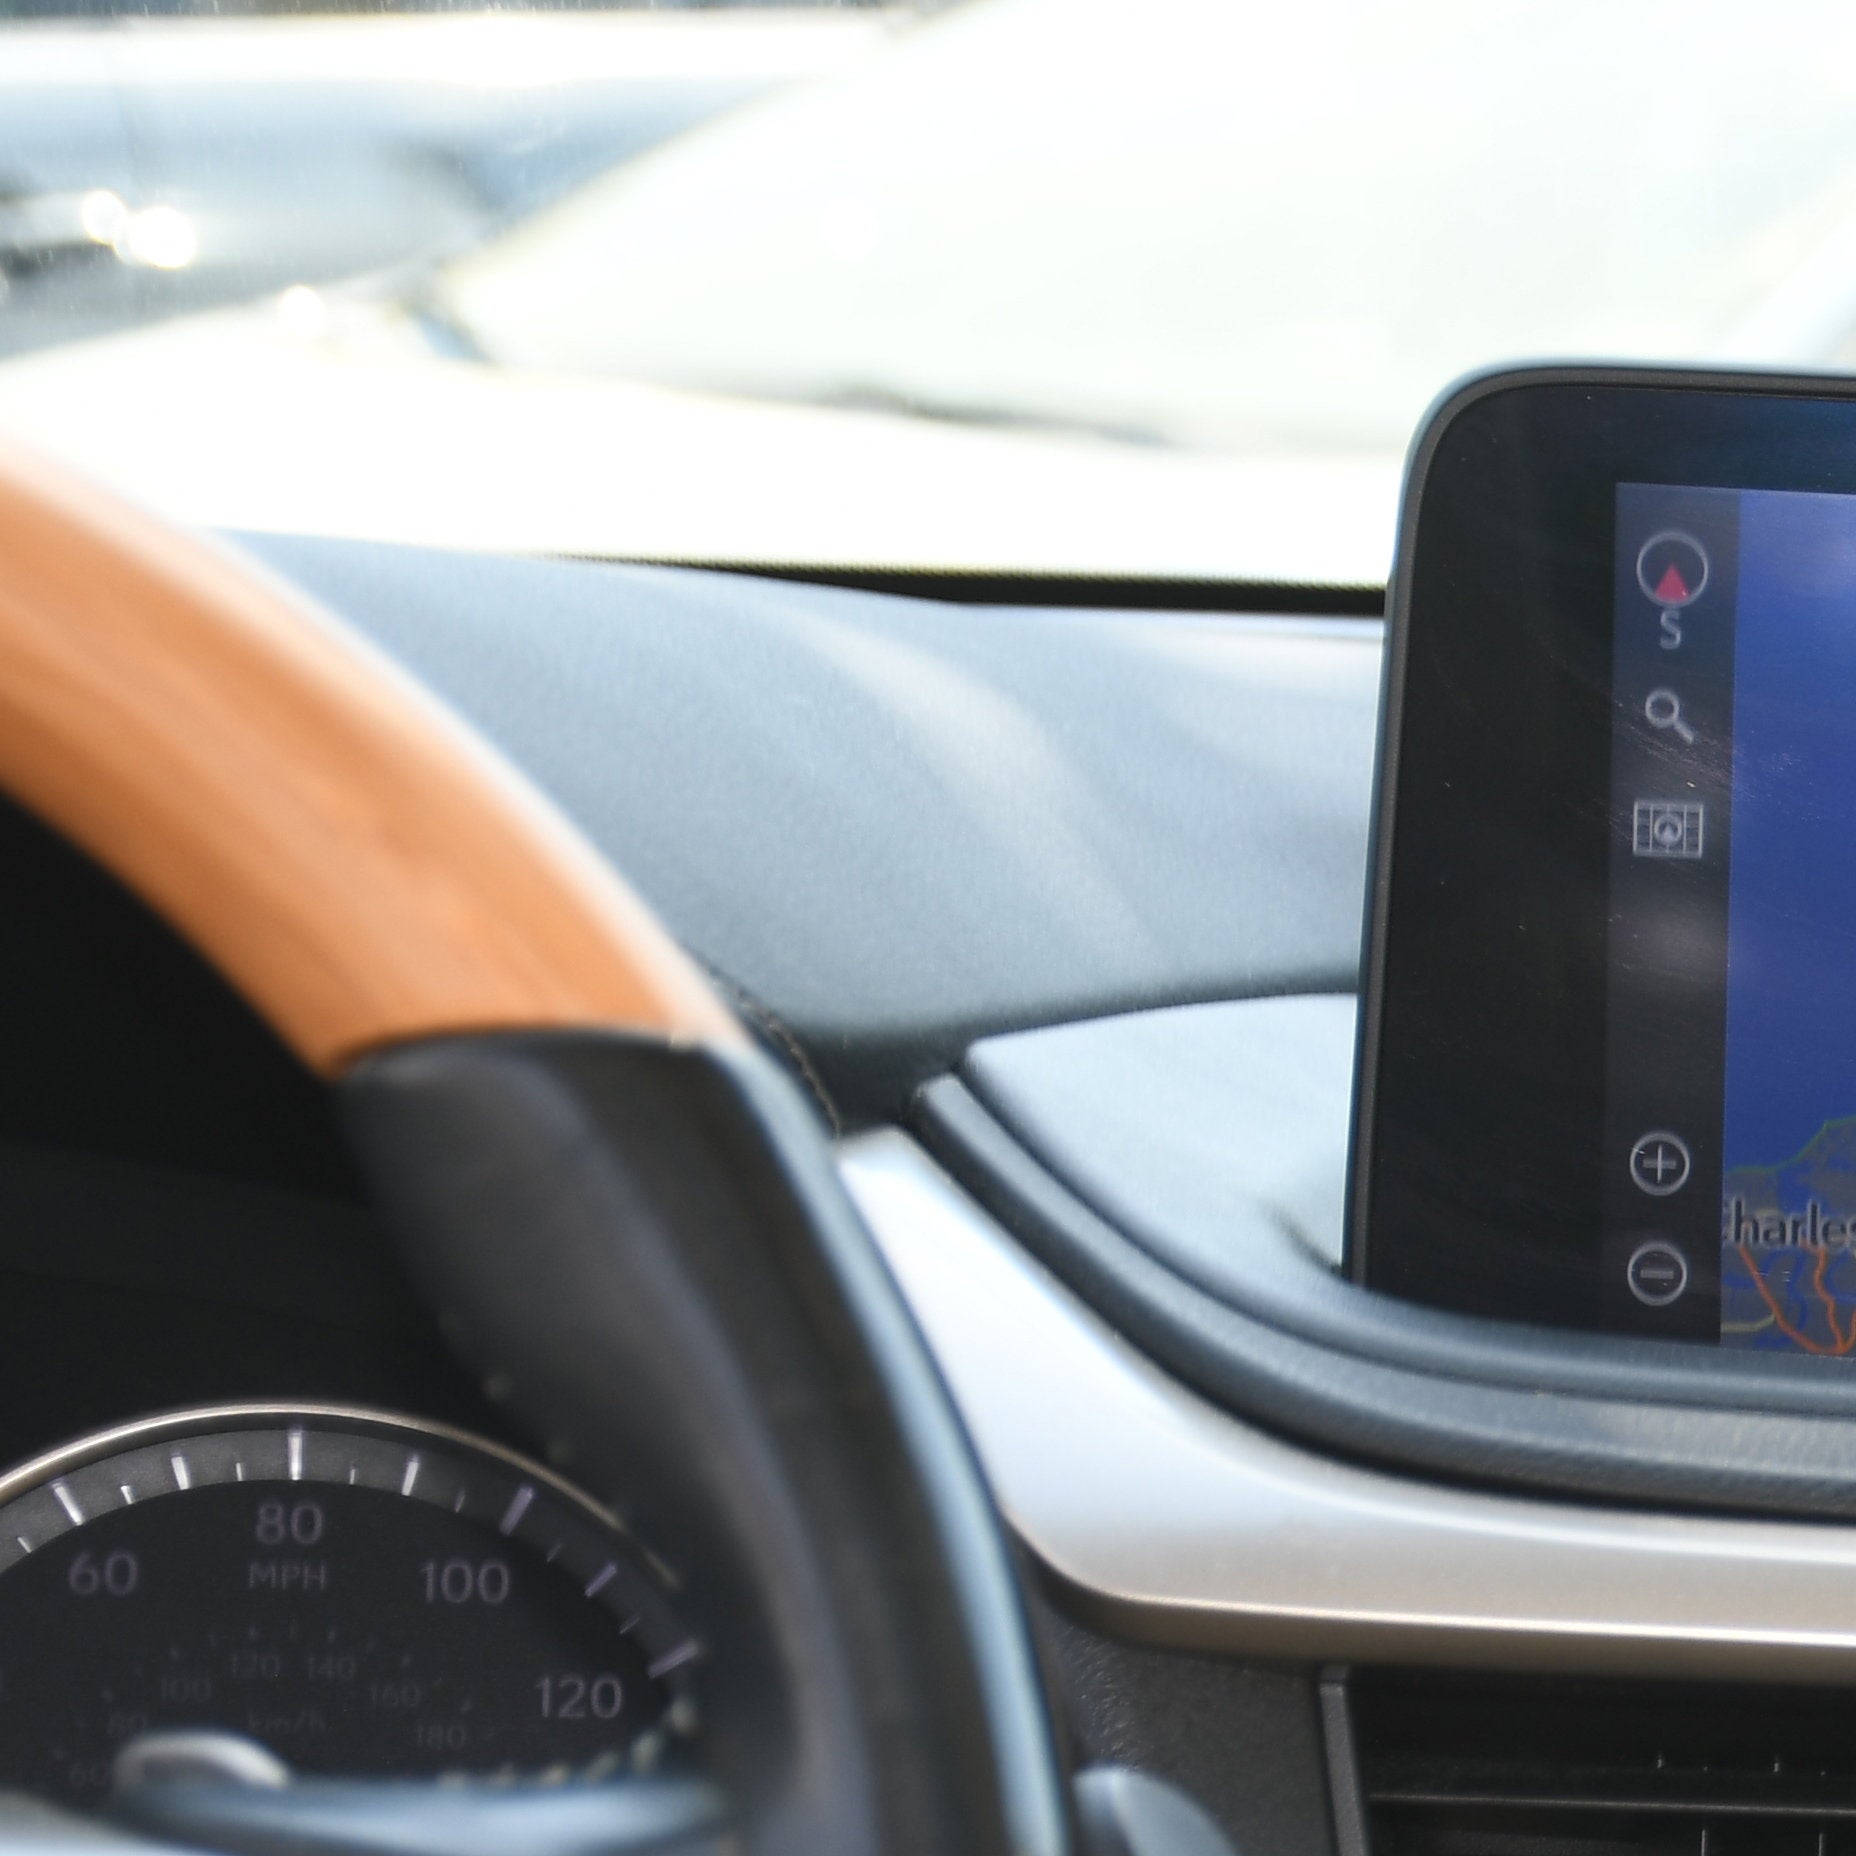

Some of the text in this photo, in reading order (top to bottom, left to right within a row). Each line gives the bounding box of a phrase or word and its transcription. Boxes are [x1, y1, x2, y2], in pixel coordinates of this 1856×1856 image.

[1659, 609, 1682, 650] S
[255, 1502, 324, 1546] 80
[68, 1552, 138, 1597] 60
[249, 1562, 328, 1592] MPH
[419, 1560, 510, 1604] 100
[534, 1675, 623, 1720] 120
